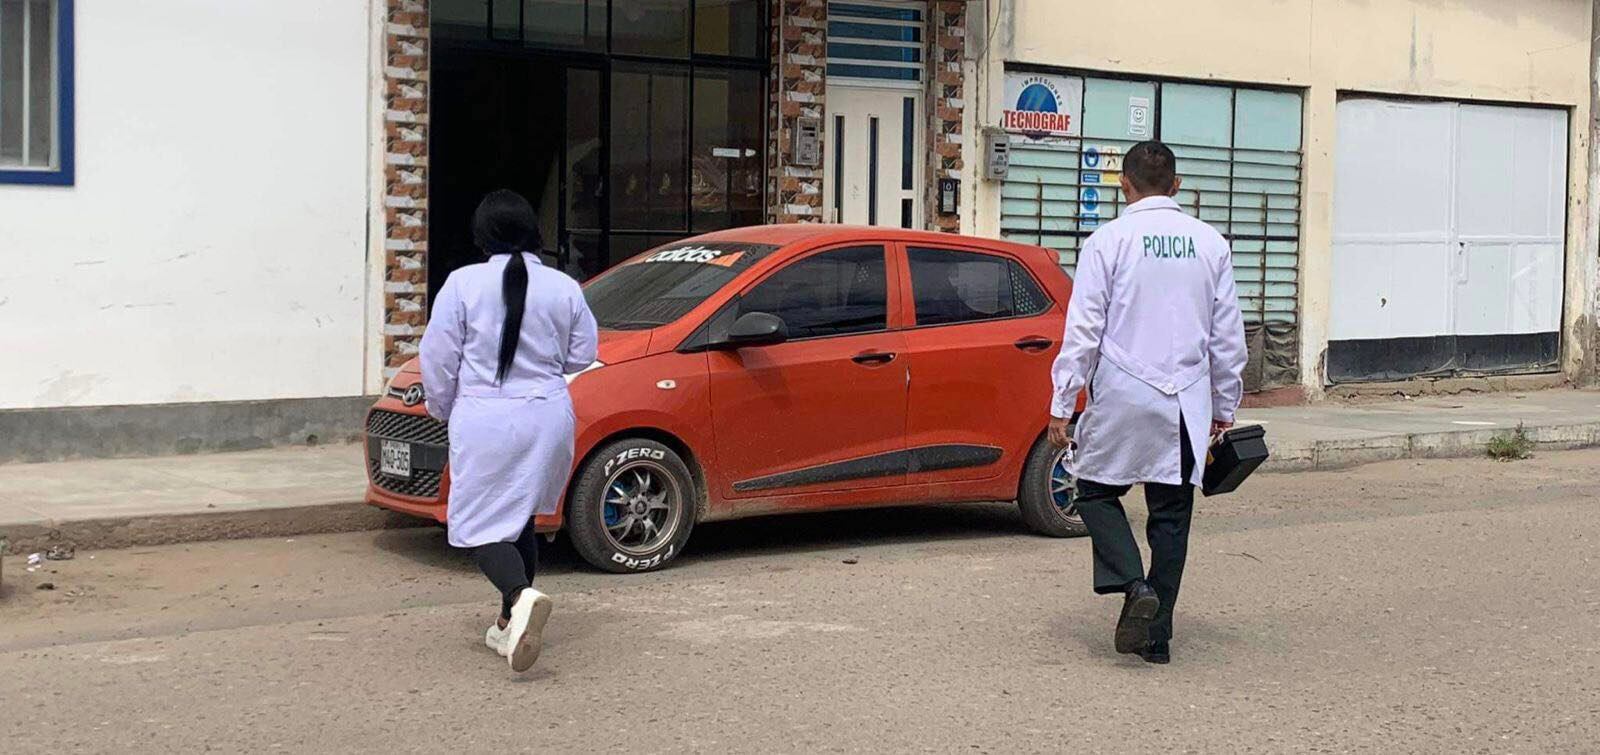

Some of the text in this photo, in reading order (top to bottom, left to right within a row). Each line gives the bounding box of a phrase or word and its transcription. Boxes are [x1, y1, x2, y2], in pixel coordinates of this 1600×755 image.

[1021, 77, 1063, 106] IMPRESIONES
[1003, 110, 1071, 131] TECNOGRAF
[1142, 235, 1196, 258] POLICIA
[604, 447, 665, 476] P ZERO
[611, 552, 661, 569] ZERO
